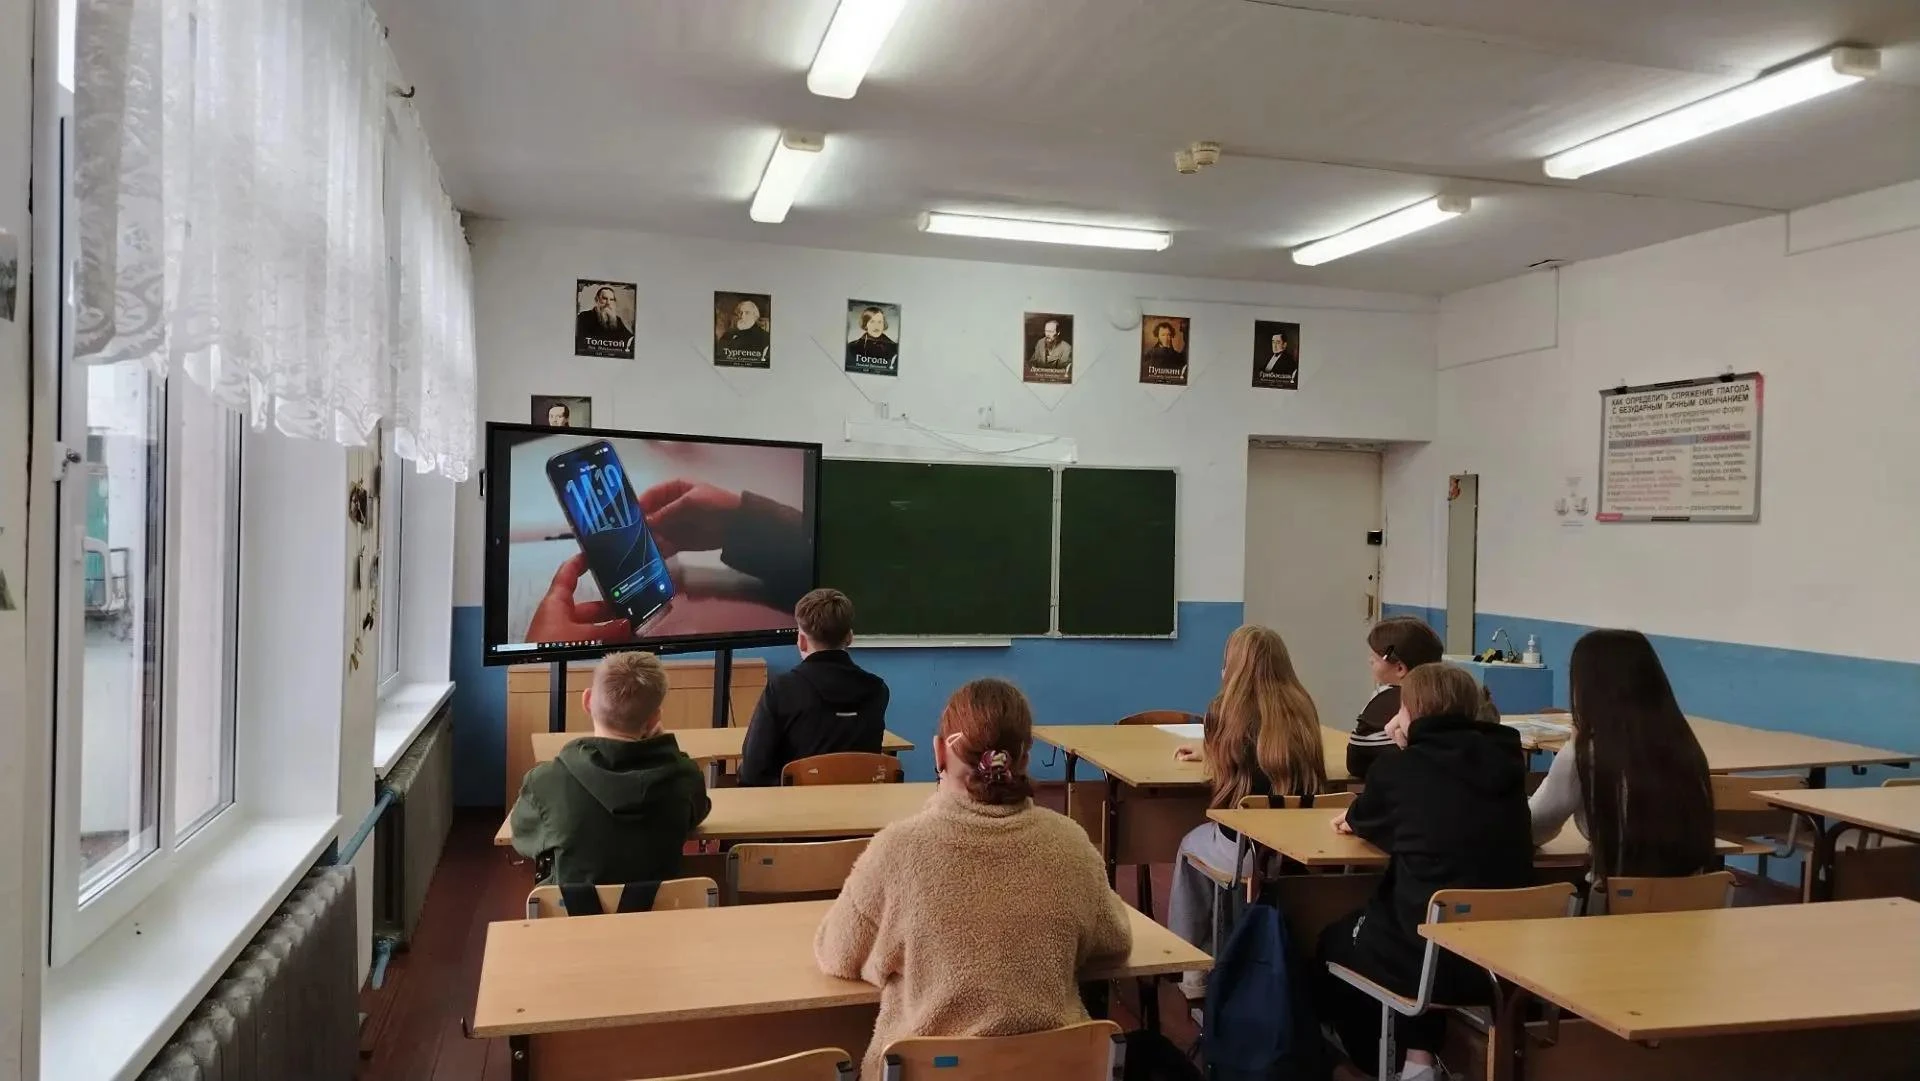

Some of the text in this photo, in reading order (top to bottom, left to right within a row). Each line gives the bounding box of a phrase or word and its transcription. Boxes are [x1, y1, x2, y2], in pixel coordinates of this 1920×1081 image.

[586, 337, 625, 348] Толстой
[723, 347, 762, 358] Тургенев
[856, 354, 888, 366] Гоголь
[1148, 366, 1181, 375] Пушкин
[1612, 384, 1750, 407] КАК ОПРЕДЕЛИТЬ СПРЯЖЕНИЕ ГЛАГОЛА
[1619, 402, 1663, 414] БЕЗУДАРНЫМ
[1665, 399, 1695, 409] ЛИЧНЫМ
[1700, 394, 1749, 406] ОКОНЧАНИЕМ
